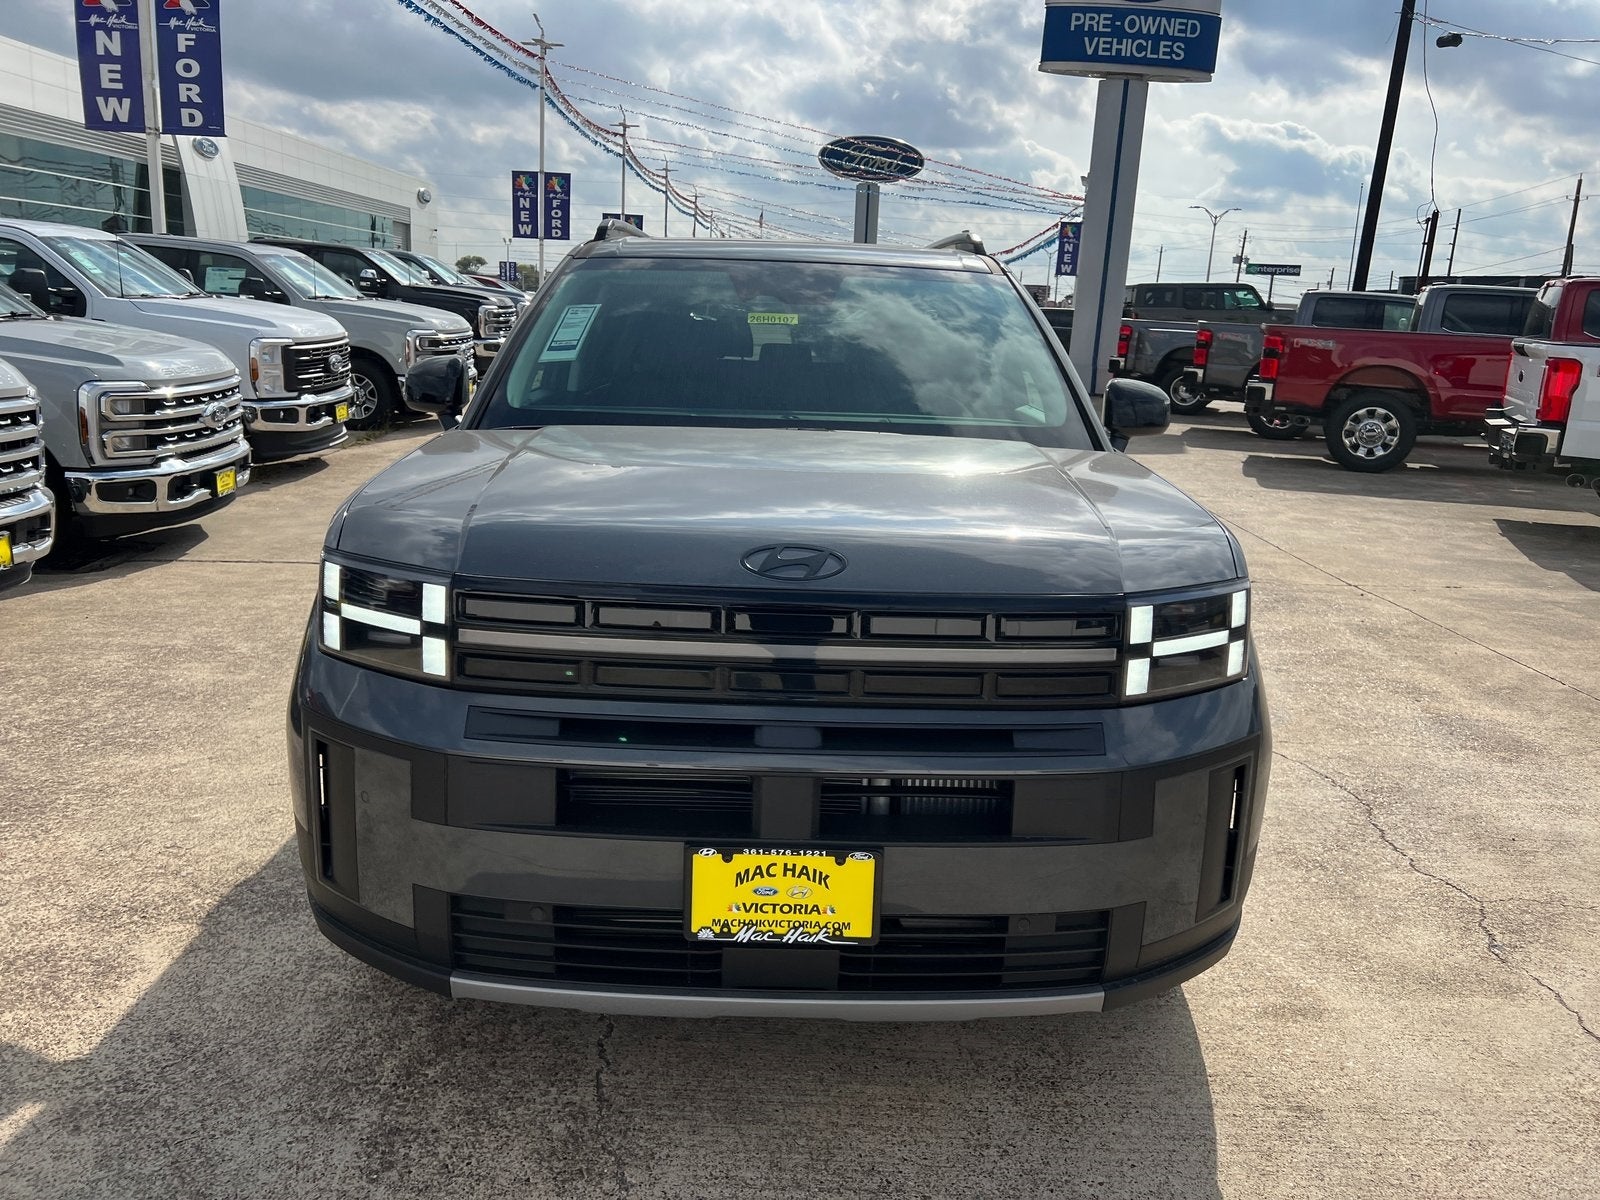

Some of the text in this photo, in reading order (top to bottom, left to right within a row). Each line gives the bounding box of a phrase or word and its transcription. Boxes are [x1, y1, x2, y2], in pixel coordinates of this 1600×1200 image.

[1084, 36, 1185, 61] VEHICLES
[95, 30, 131, 123] NEW
[175, 33, 203, 127] FORD
[843, 144, 903, 172] Ford
[518, 197, 532, 235] NEW
[551, 199, 562, 238] FORD
[1060, 243, 1074, 273] NEW
[1248, 265, 1300, 275] enterprise
[750, 315, 796, 323] 26H0107
[742, 848, 827, 857] 361-576-1221
[734, 862, 831, 891] MAC HAIK
[742, 902, 821, 915] VICTORIA
[711, 918, 851, 931] MACHAIKVICTORIA.COM
[732, 925, 834, 944] Mac Haik
